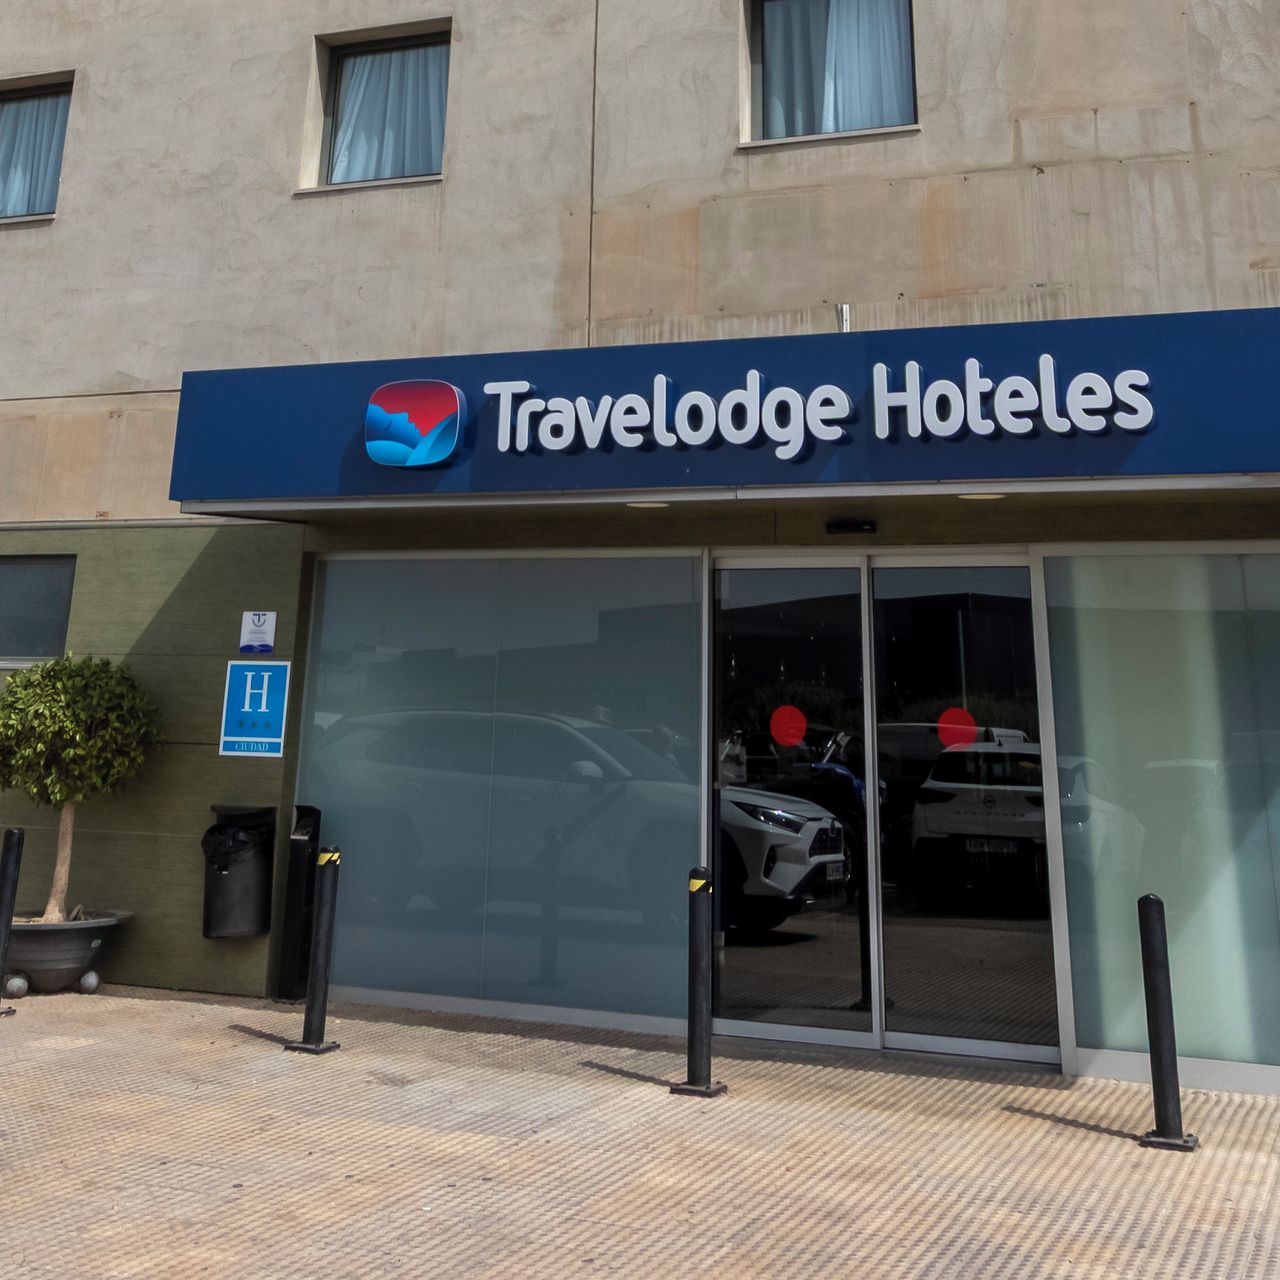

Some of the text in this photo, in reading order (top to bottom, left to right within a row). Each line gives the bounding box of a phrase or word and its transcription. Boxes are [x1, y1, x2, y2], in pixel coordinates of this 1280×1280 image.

[483, 353, 1155, 460] Travelodge Hoteles
[241, 672, 272, 712] H
[235, 742, 269, 752] CIUDAD
